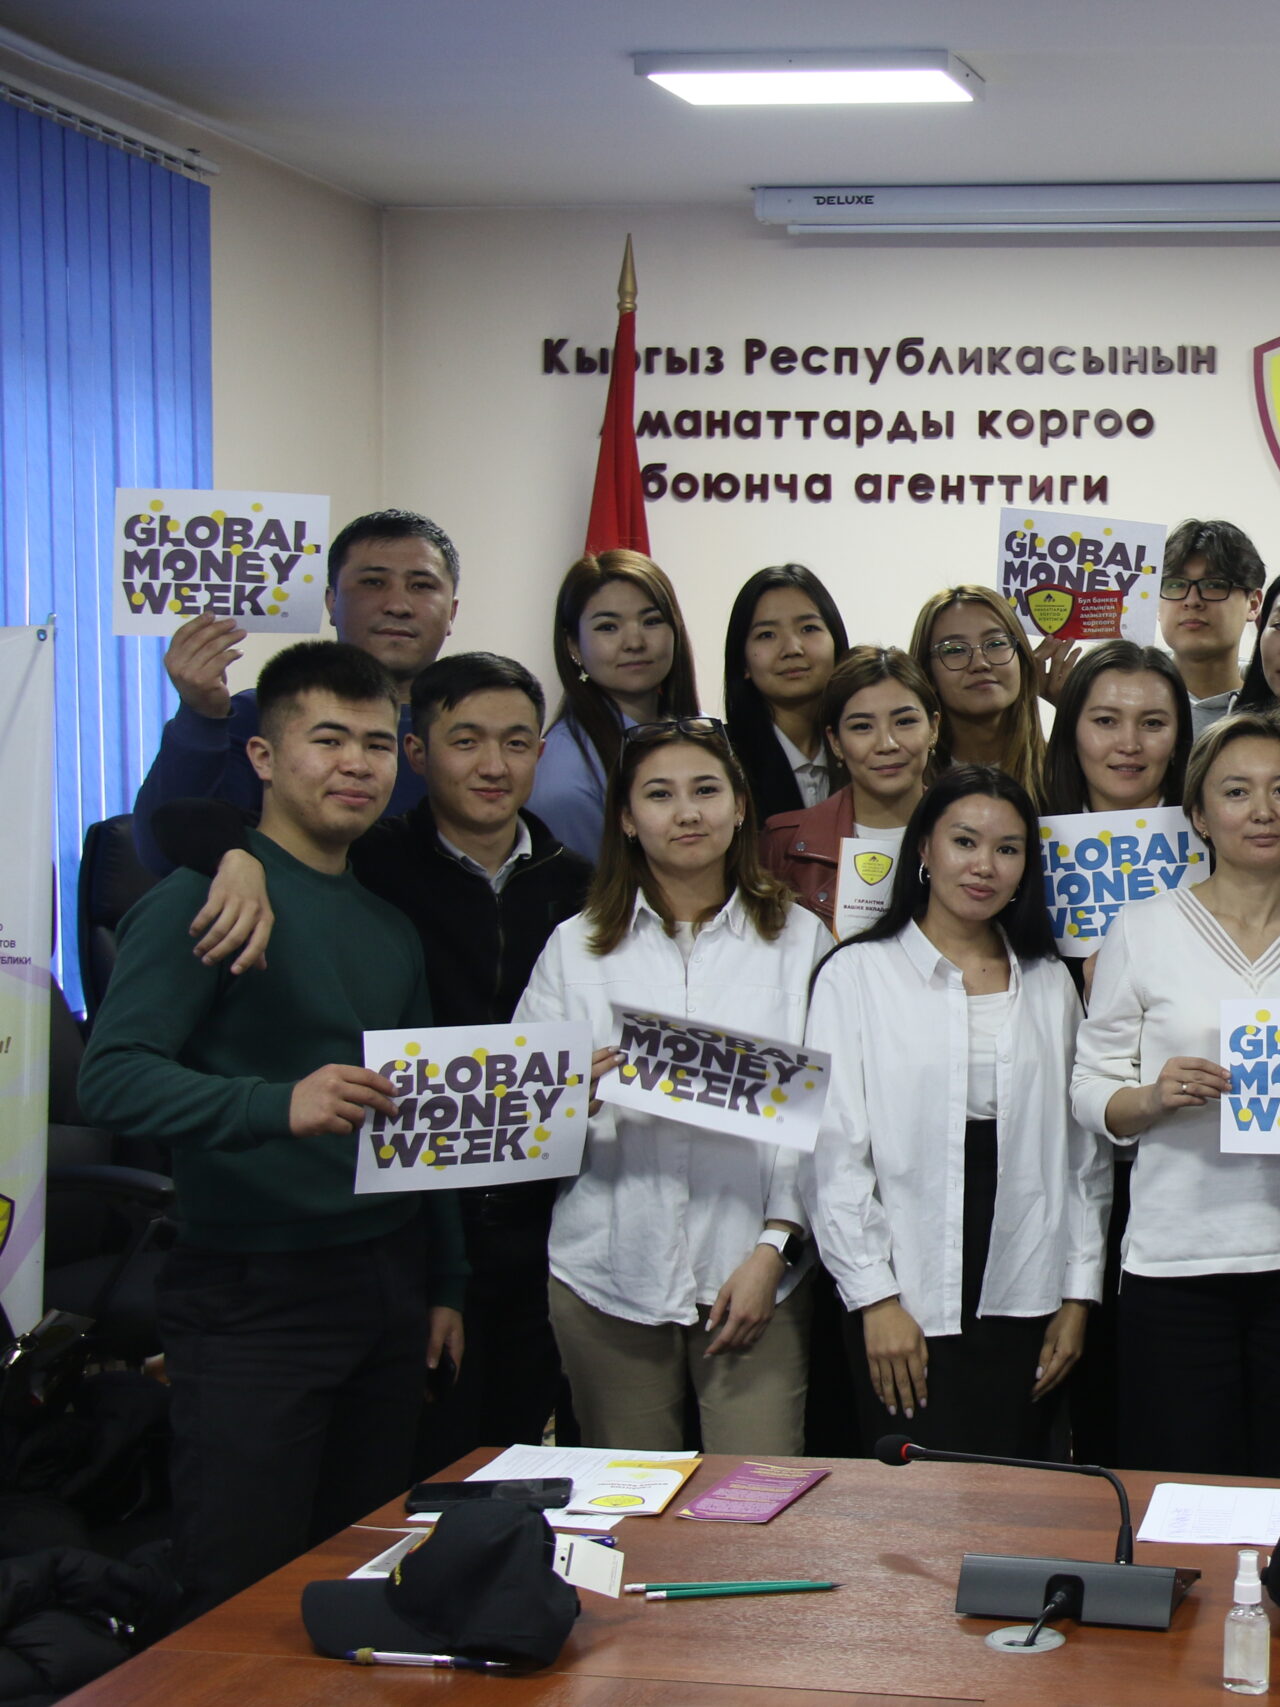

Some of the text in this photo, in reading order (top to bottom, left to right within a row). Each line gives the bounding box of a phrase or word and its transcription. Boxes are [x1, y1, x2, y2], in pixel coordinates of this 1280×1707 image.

[813, 195, 875, 206] DELUXE
[543, 337, 1217, 384] Кыгыз Республикасынын
[599, 408, 1155, 448] манаттарды коргоо
[641, 463, 1109, 504] боюнча агенттиги
[124, 514, 321, 553] GLOBAL
[1005, 530, 1157, 574] GLOBAL
[123, 548, 302, 585] MONEY
[1003, 560, 1141, 597] MONEY
[122, 581, 268, 616] WEEK
[378, 1050, 584, 1098] GLOBAL
[619, 1022, 803, 1085] MONEY
[618, 1053, 768, 1116] WEEK
[372, 1087, 565, 1132] MONEY
[370, 1126, 530, 1169] WEEK
